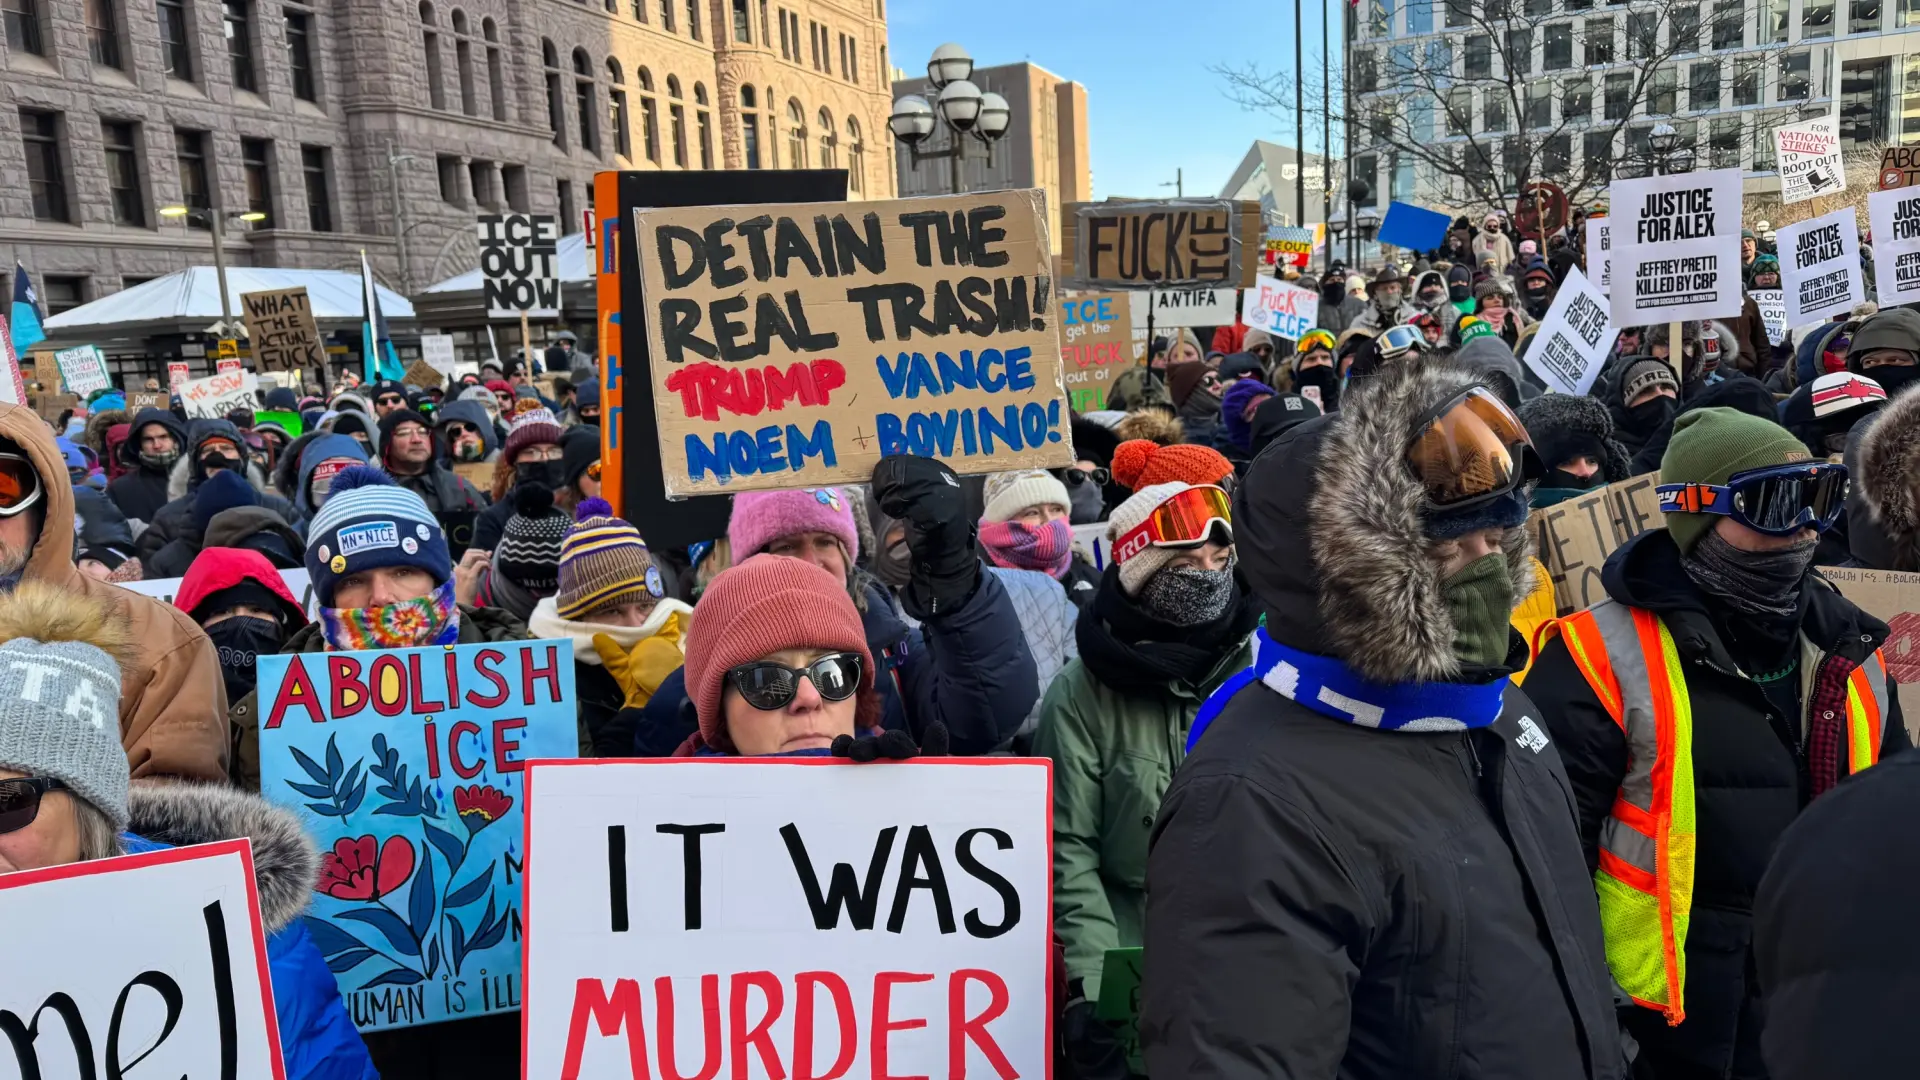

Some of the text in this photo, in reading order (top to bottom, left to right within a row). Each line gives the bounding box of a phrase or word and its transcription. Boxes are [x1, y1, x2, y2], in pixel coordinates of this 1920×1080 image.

[1778, 131, 1836, 145] NATIONAL
[1811, 124, 1829, 132] FOR
[1781, 140, 1827, 152] STRIKES
[1782, 153, 1798, 163] TO
[1783, 154, 1838, 175] BOOT OUT
[1824, 165, 1842, 188] ADMIN
[1788, 176, 1805, 186] THE
[1641, 188, 1713, 218] JUSTICE
[477, 215, 556, 247] ICE
[1637, 213, 1715, 244] FOR ALEX
[1796, 223, 1841, 252] JUSTICE
[655, 212, 887, 291] DETAIN
[900, 205, 1010, 268] THE
[1089, 211, 1230, 280] FUCK ICE
[1267, 240, 1310, 252] ICE OUT
[1796, 239, 1844, 269] FOR ALEX
[481, 246, 557, 278] OUT
[1636, 255, 1717, 278] JEFFREY PRETTI
[1635, 272, 1717, 296] KILLED BY CBP
[1799, 268, 1848, 293] JEFFREY PRETTI
[1800, 280, 1849, 305] KILLED BY CBP
[244, 293, 307, 318] WHAT
[483, 278, 559, 310] NOW
[1159, 290, 1217, 308] ANTIFA
[1637, 299, 1650, 308] PARTY
[1651, 298, 1659, 306] FOR
[1660, 296, 1683, 305] SOCIALISM
[1690, 293, 1716, 302] LIBERATION
[659, 289, 839, 363] REAL
[847, 276, 1050, 343] TRASH!
[1062, 297, 1119, 325] ICE.
[1573, 291, 1608, 332] JUSTICE
[253, 315, 301, 334] THE
[1066, 323, 1111, 342] get the
[1270, 311, 1309, 338] ICE
[1563, 304, 1602, 350] FOR ALEX
[259, 330, 313, 349] ACTUAL
[261, 345, 325, 371] FUCK
[1061, 340, 1126, 368] FUCK
[1545, 341, 1564, 364] KILLED
[1562, 355, 1573, 371] BY
[1569, 364, 1583, 382] CBP
[1569, 348, 1588, 372] PRETTI
[185, 372, 243, 401] WE SAW
[1066, 368, 1110, 383] out of
[135, 394, 158, 405] DONT
[187, 392, 258, 420] MURDER
[685, 420, 838, 486] NOEM
[875, 400, 1061, 459] BOVINO!
[341, 528, 395, 549] MN NICE
[263, 645, 563, 729] ABOLISH
[424, 715, 528, 780] ICE
[607, 821, 1021, 939] IT WAS
[560, 968, 1009, 1080] MURDER
